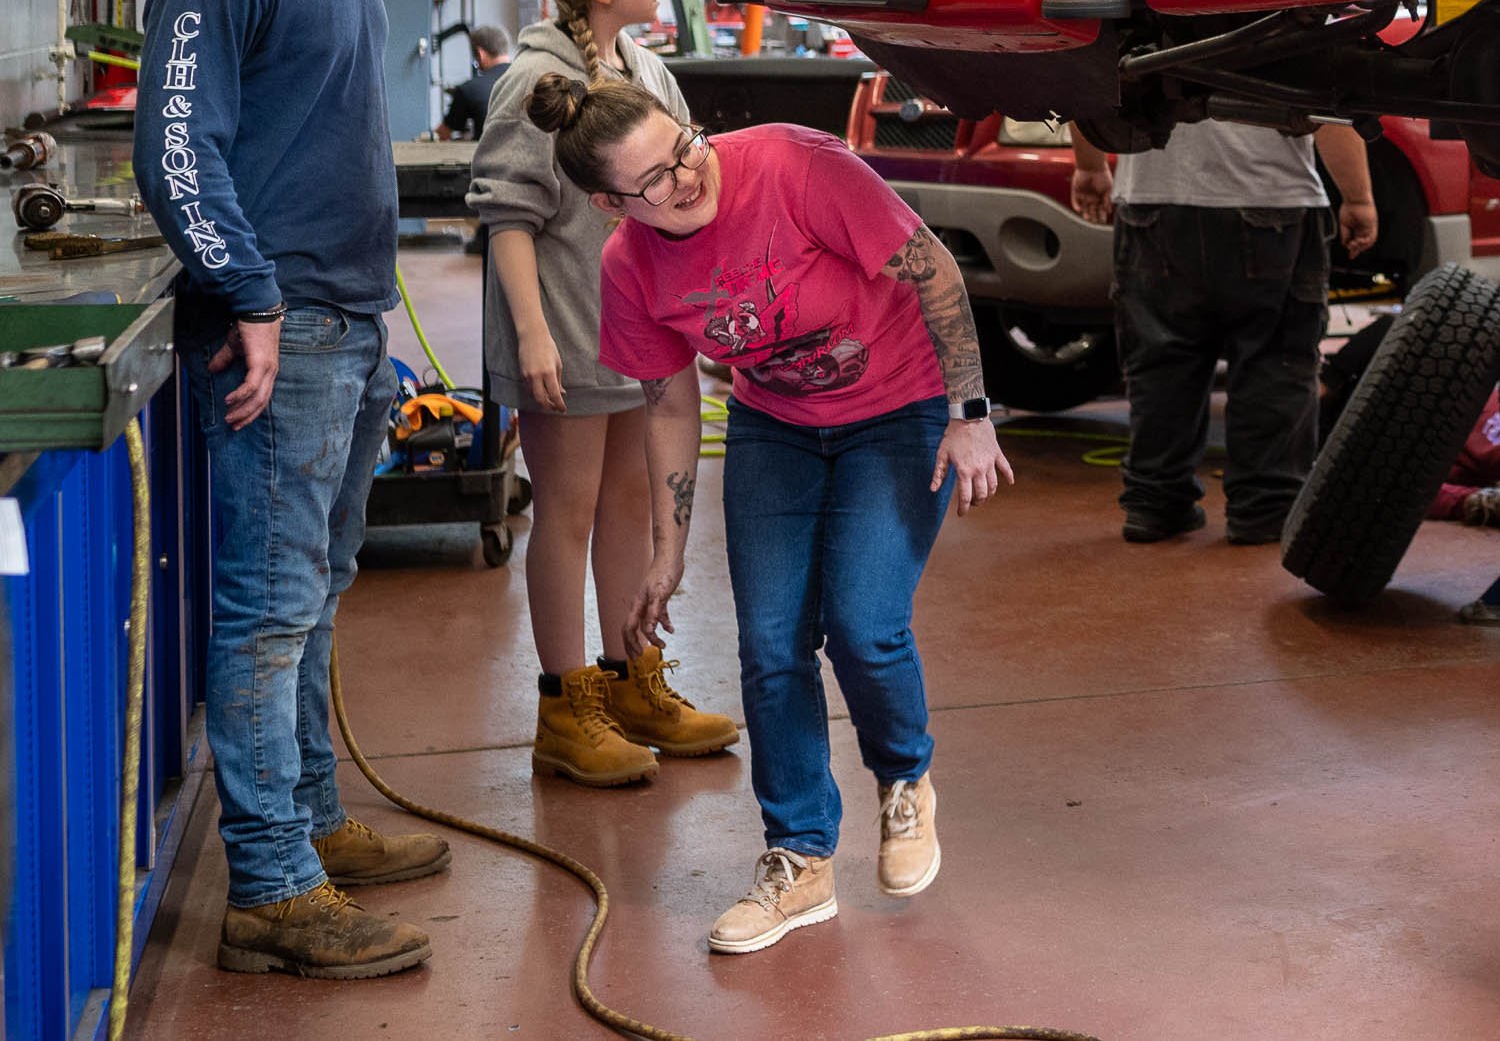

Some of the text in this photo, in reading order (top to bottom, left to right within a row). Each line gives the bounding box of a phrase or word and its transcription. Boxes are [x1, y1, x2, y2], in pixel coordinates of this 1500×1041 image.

[162, 12, 230, 269] CLH & SON INC
